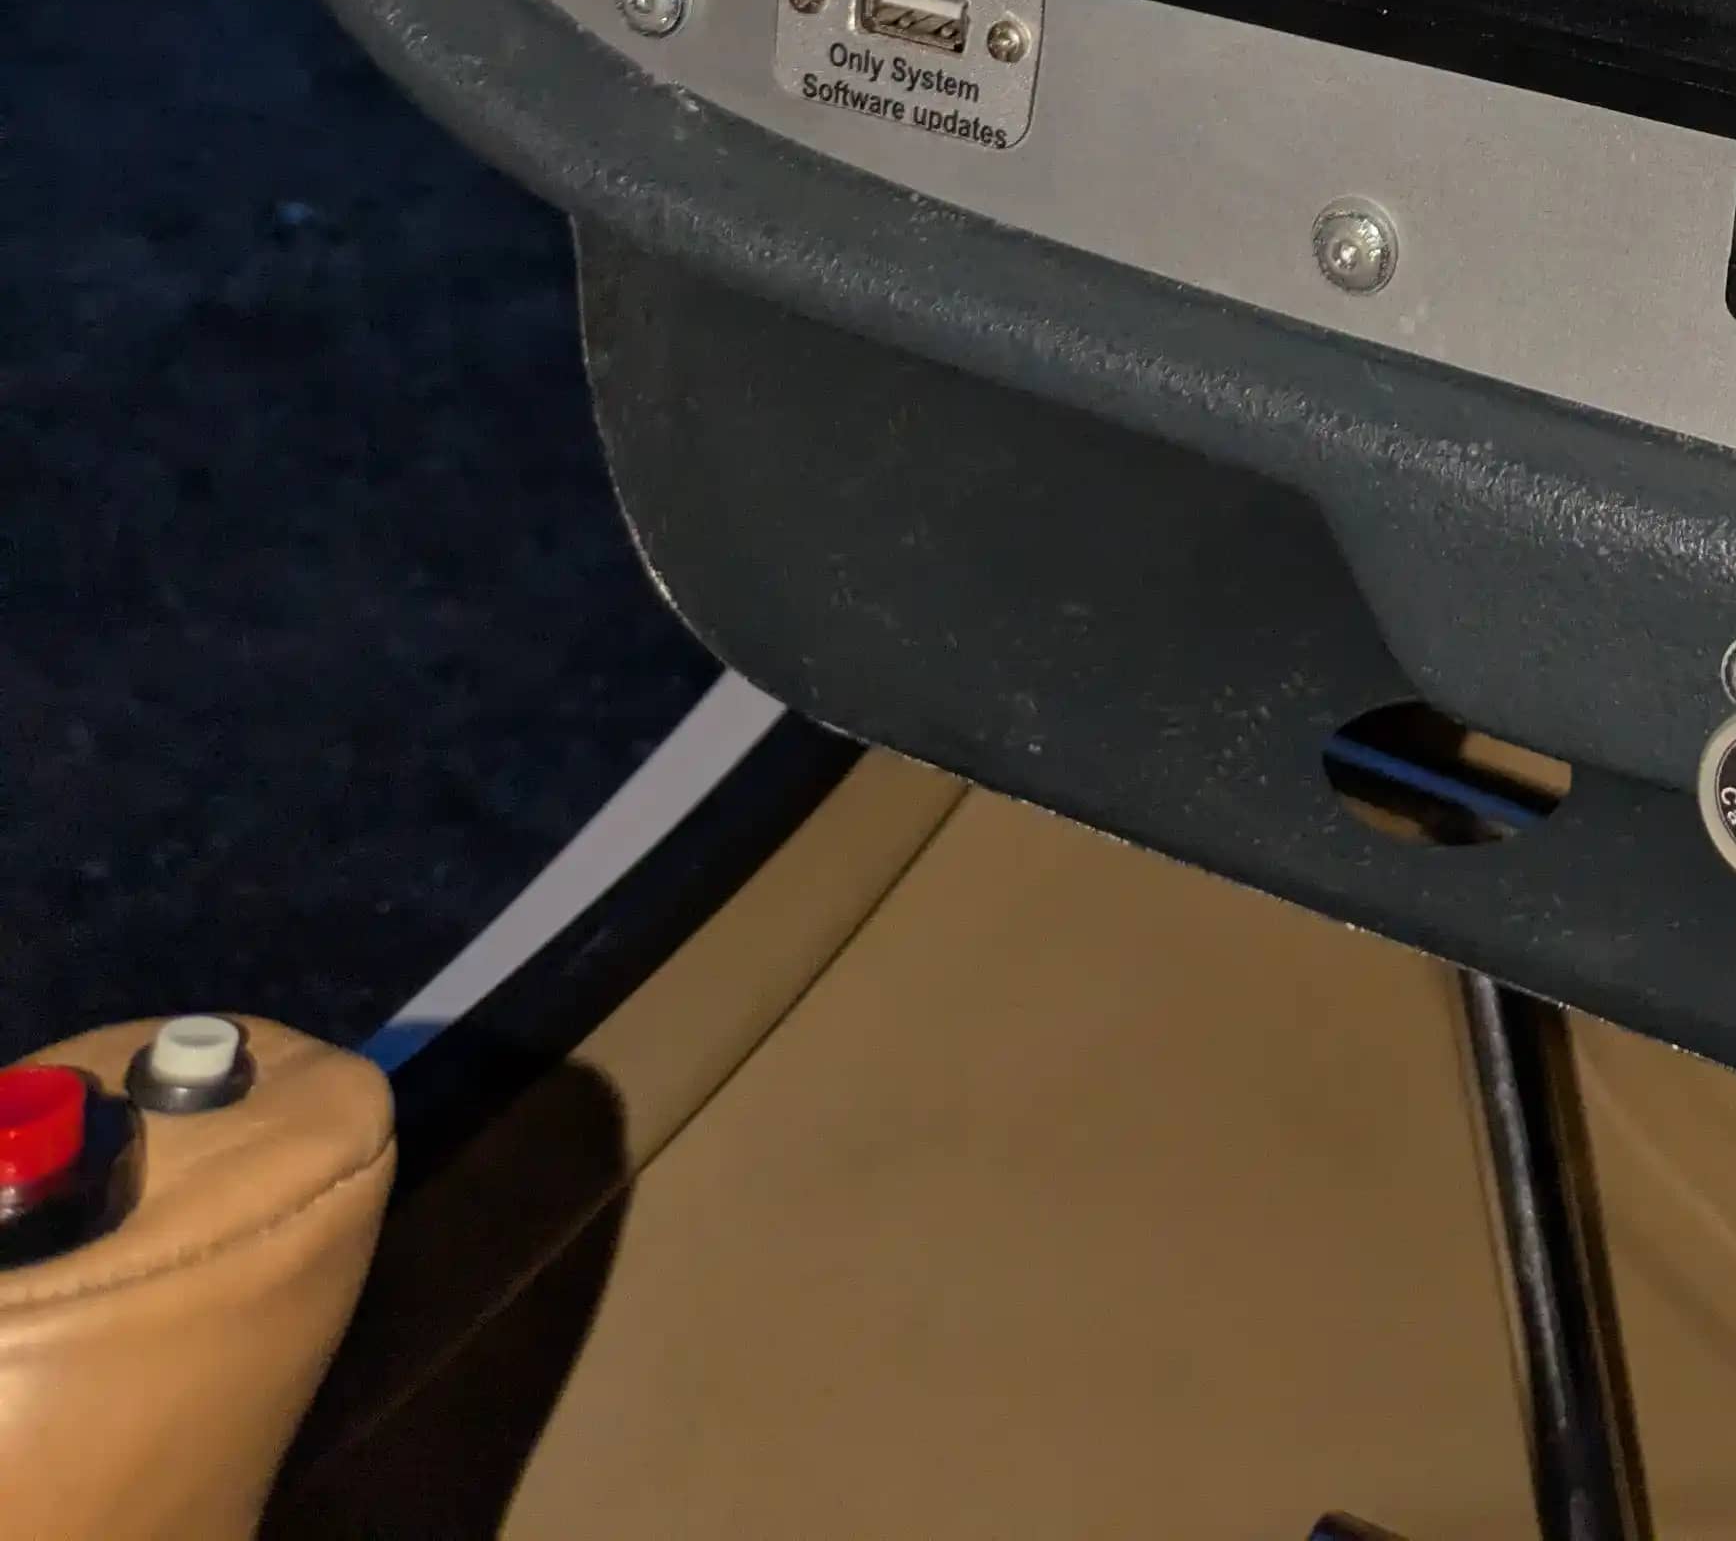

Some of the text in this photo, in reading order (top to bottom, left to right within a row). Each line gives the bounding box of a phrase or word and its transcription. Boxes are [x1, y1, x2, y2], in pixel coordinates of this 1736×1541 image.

[830, 42, 980, 102] Only System
[802, 73, 1007, 149] Software updates
